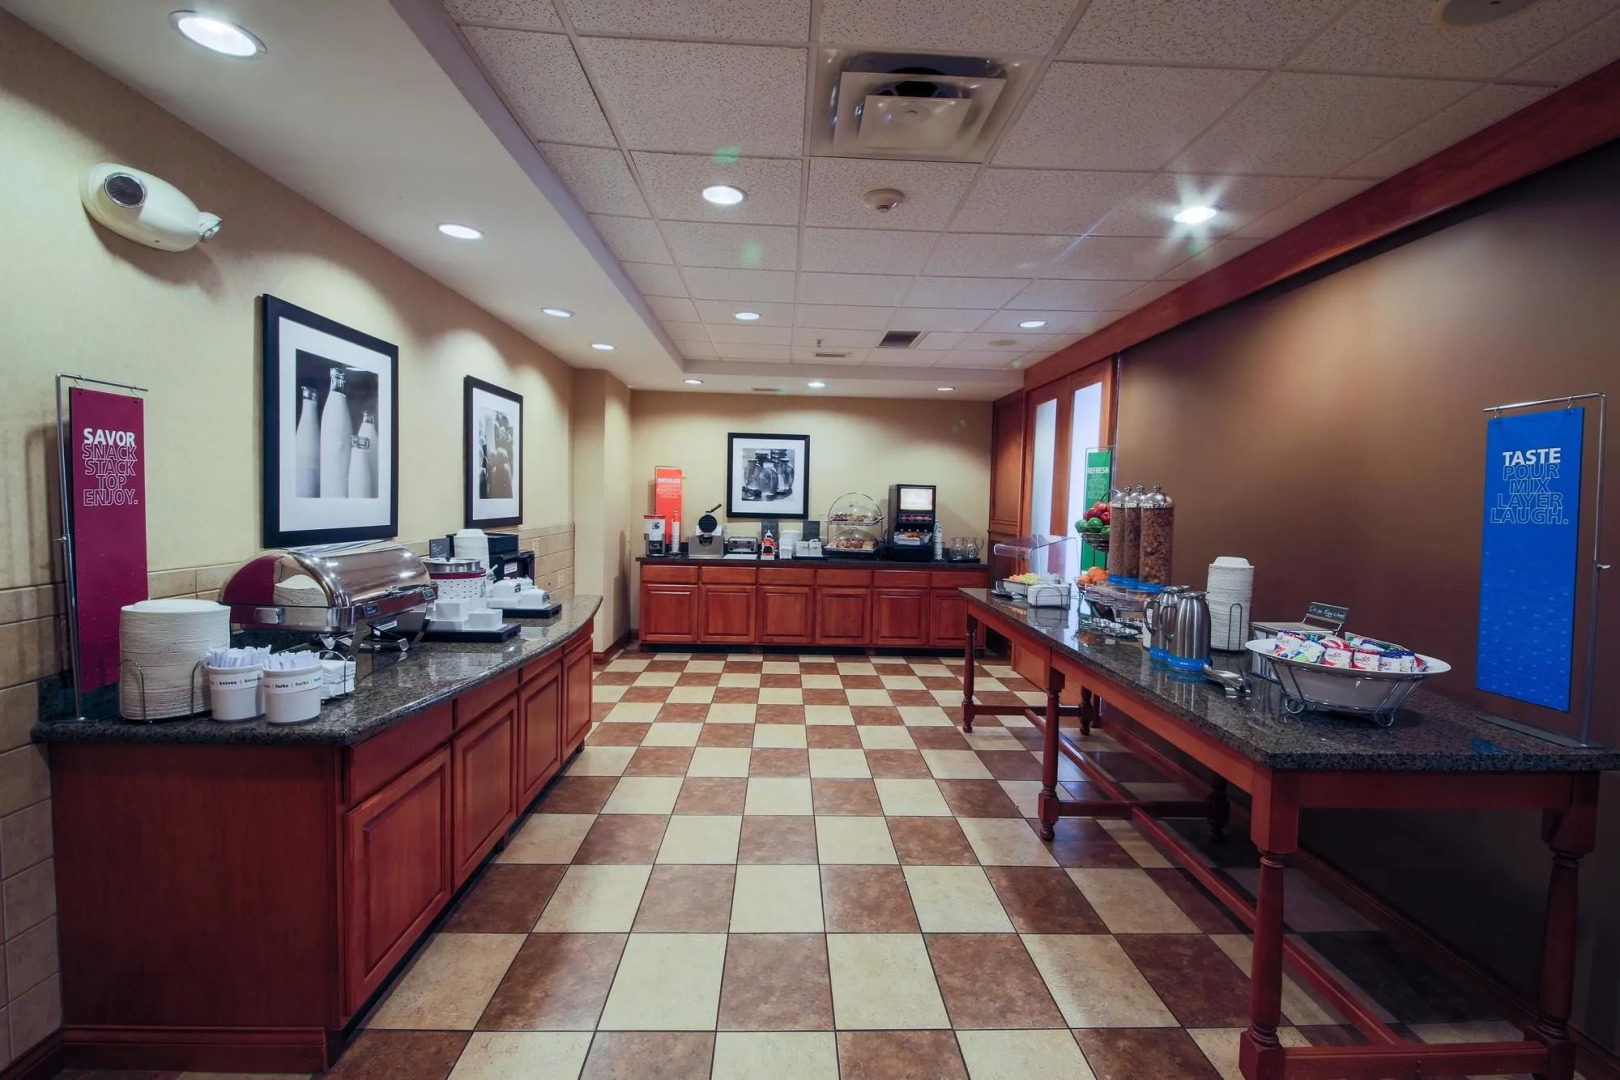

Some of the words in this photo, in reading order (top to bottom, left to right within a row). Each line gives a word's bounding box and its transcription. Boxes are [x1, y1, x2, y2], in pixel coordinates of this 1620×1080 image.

[83, 427, 136, 447] SAVOR
[82, 443, 138, 462] SNACK
[1502, 447, 1562, 467] TASTE
[84, 459, 137, 476] STACK
[1502, 462, 1560, 481] POUR
[96, 474, 127, 491] TOP
[1509, 477, 1552, 495] MIX
[83, 488, 139, 507] ENJOY.
[1497, 491, 1564, 510] LAYER
[1490, 506, 1569, 525] LAUGH.
